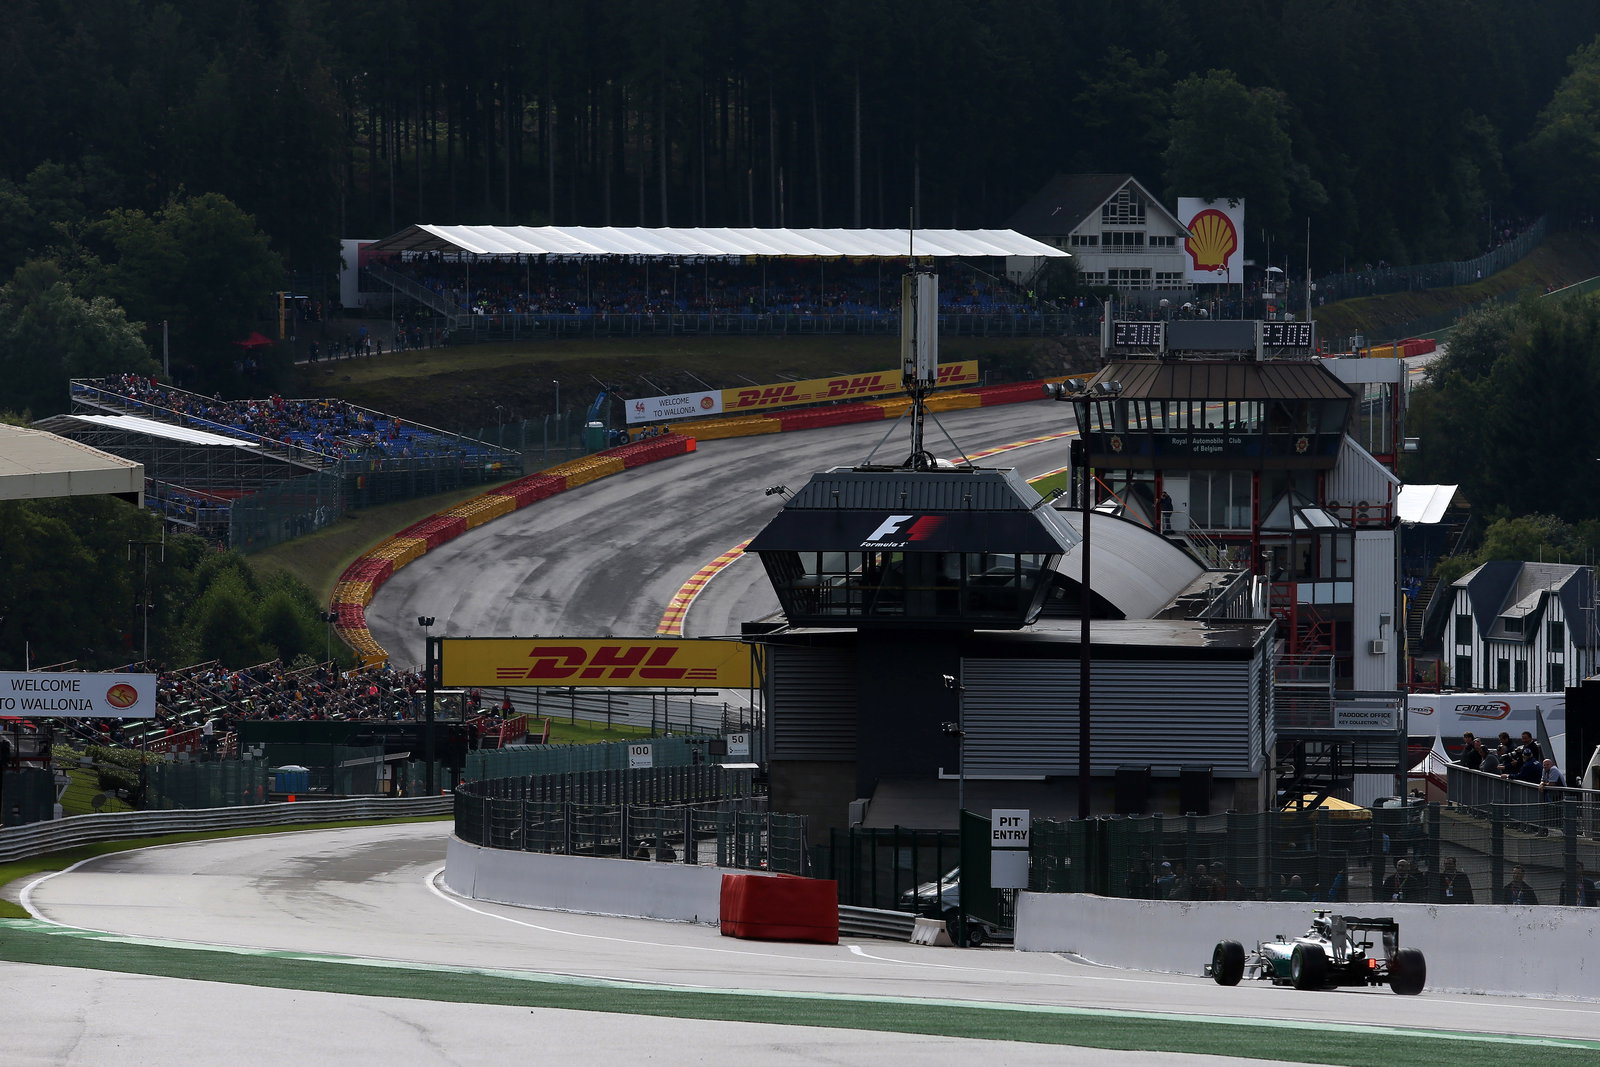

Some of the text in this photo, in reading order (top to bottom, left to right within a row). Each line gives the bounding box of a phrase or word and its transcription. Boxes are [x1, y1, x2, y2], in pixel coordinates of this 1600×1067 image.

[826, 375, 886, 397] DHL
[737, 385, 801, 408] DHL
[659, 397, 689, 407] WELCOME
[664, 406, 695, 416] WALLONIA
[1171, 437, 1188, 445] Royal
[1200, 445, 1223, 453] Belgium
[526, 646, 689, 680] DHL
[11, 679, 81, 692] WELCOME
[21, 698, 93, 711] WALLONIA
[732, 735, 744, 743] 50
[632, 746, 649, 755] 100
[1000, 816, 1020, 827] PIT
[993, 830, 1027, 840] ENTRY
